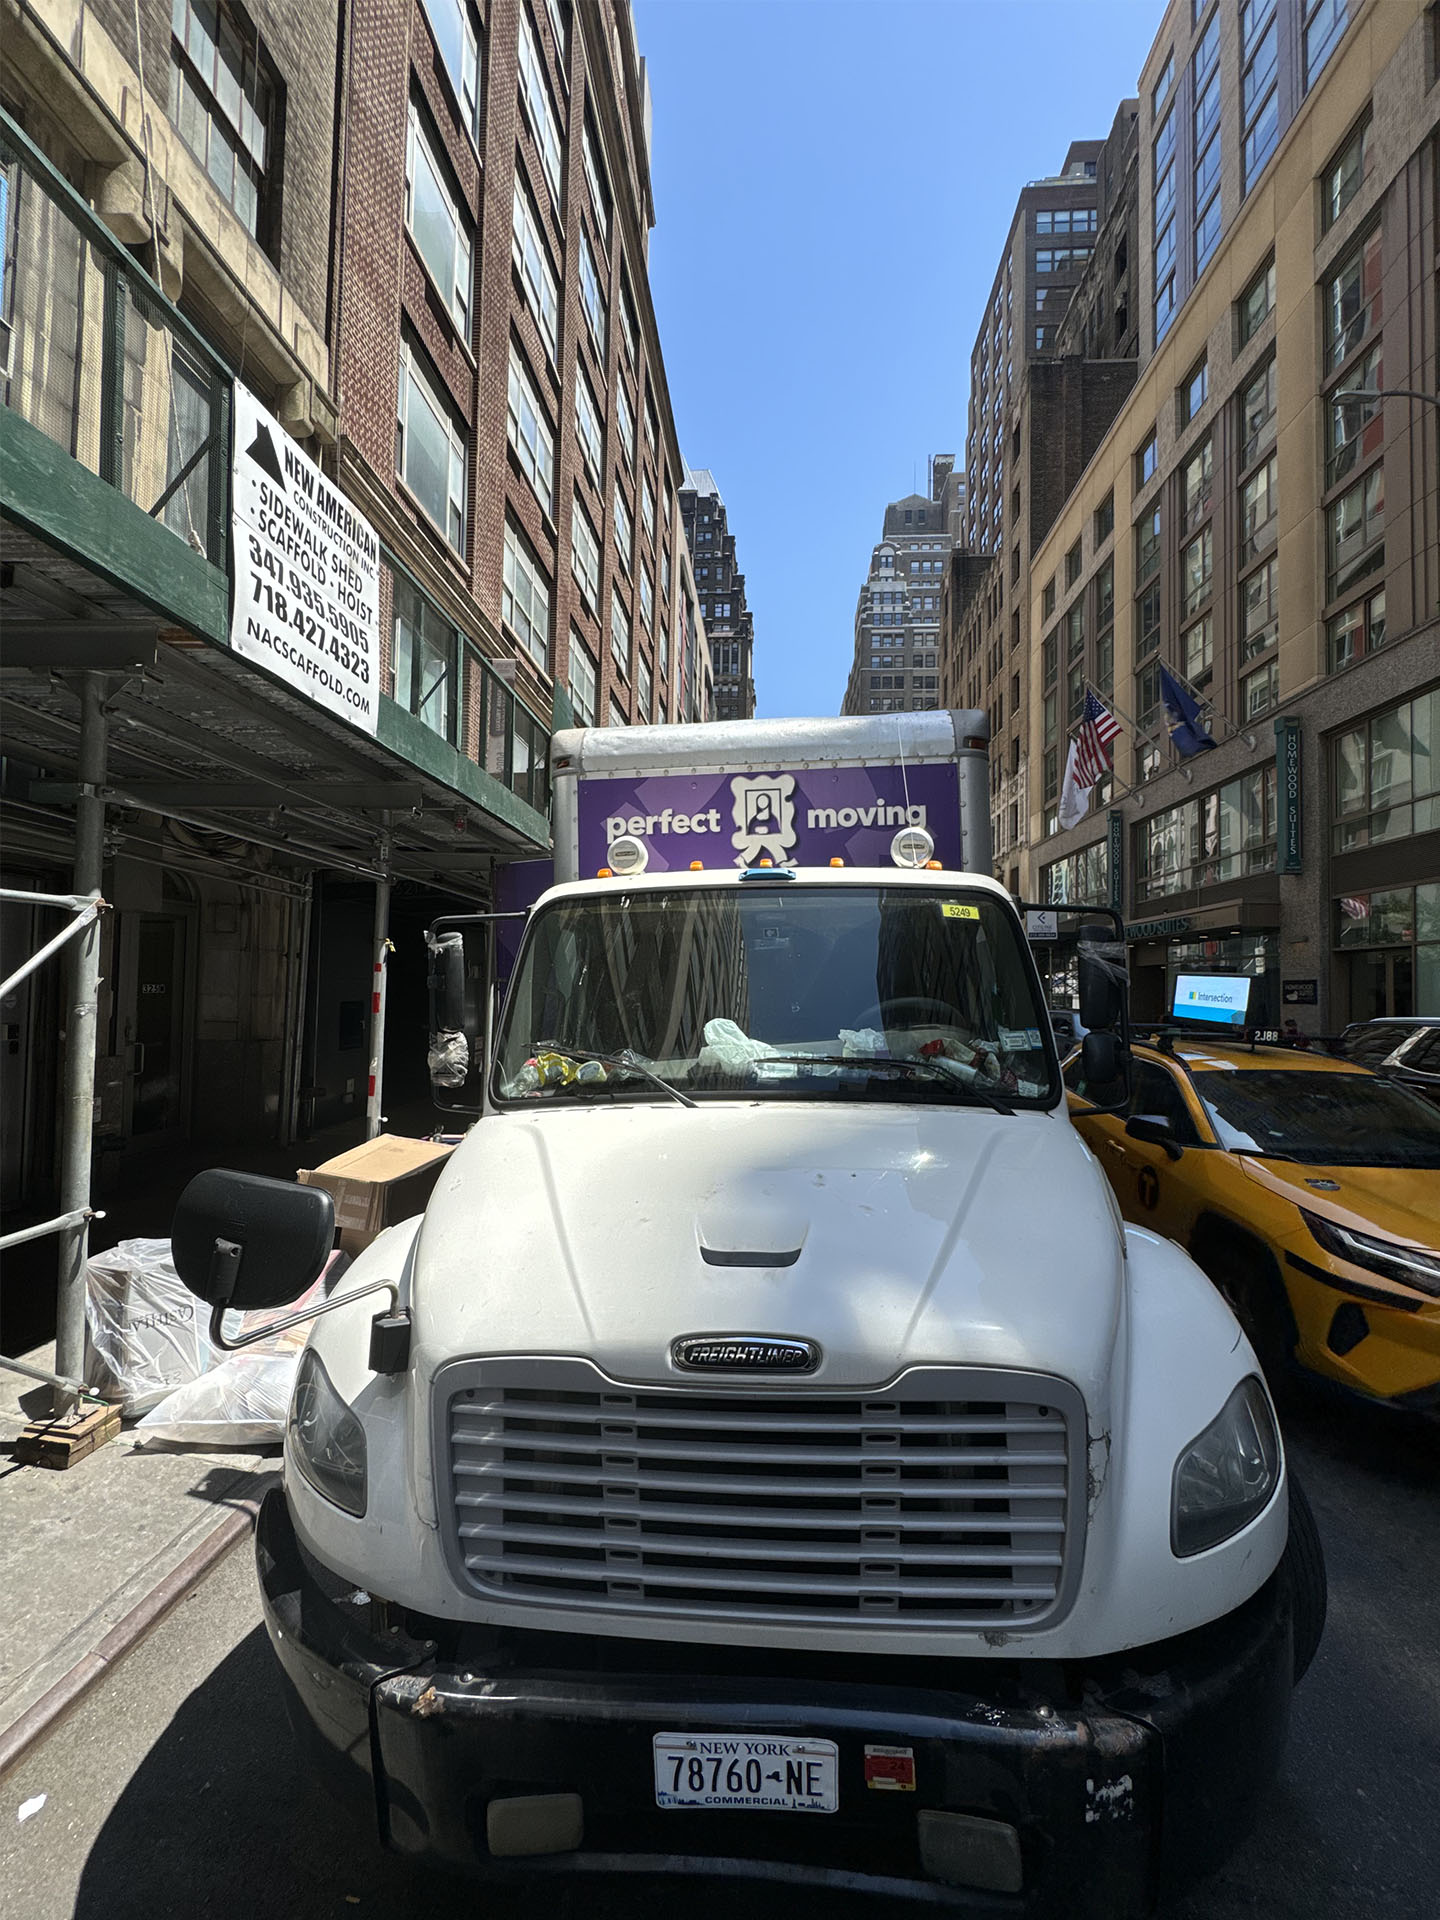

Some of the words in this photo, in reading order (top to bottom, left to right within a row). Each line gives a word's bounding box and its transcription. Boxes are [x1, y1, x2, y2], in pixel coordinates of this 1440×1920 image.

[285, 445, 315, 500] NEW
[316, 482, 376, 564] AMERICAN
[293, 490, 359, 564] CONSTRUCTION
[260, 482, 328, 566] SIDEWALK
[331, 553, 362, 594] SHED
[258, 509, 326, 585] SCAFFOLD
[337, 582, 373, 624] HOIST
[249, 534, 369, 654] 347.935.5905
[250, 571, 370, 684] 718.427.4323
[247, 616, 370, 715] NACSCAFFOLD.COM
[1287, 734, 1298, 799] HOMEWOOD
[606, 808, 721, 844] perfect
[807, 799, 927, 829] moving
[1289, 806, 1297, 855] SUITES
[949, 906, 971, 917] 5249
[1125, 923, 1156, 938] WOOD
[1157, 916, 1189, 934] SUITES
[1198, 991, 1233, 1003] Intersection
[1254, 1030, 1279, 1042] 2J88
[689, 1346, 802, 1364] FREIGHTLINER
[699, 1742, 741, 1756] NEW
[744, 1743, 792, 1756] YORK
[667, 1757, 763, 1794] 78760
[786, 1760, 824, 1797] NE
[704, 1796, 788, 1806] COMMERCIAL
